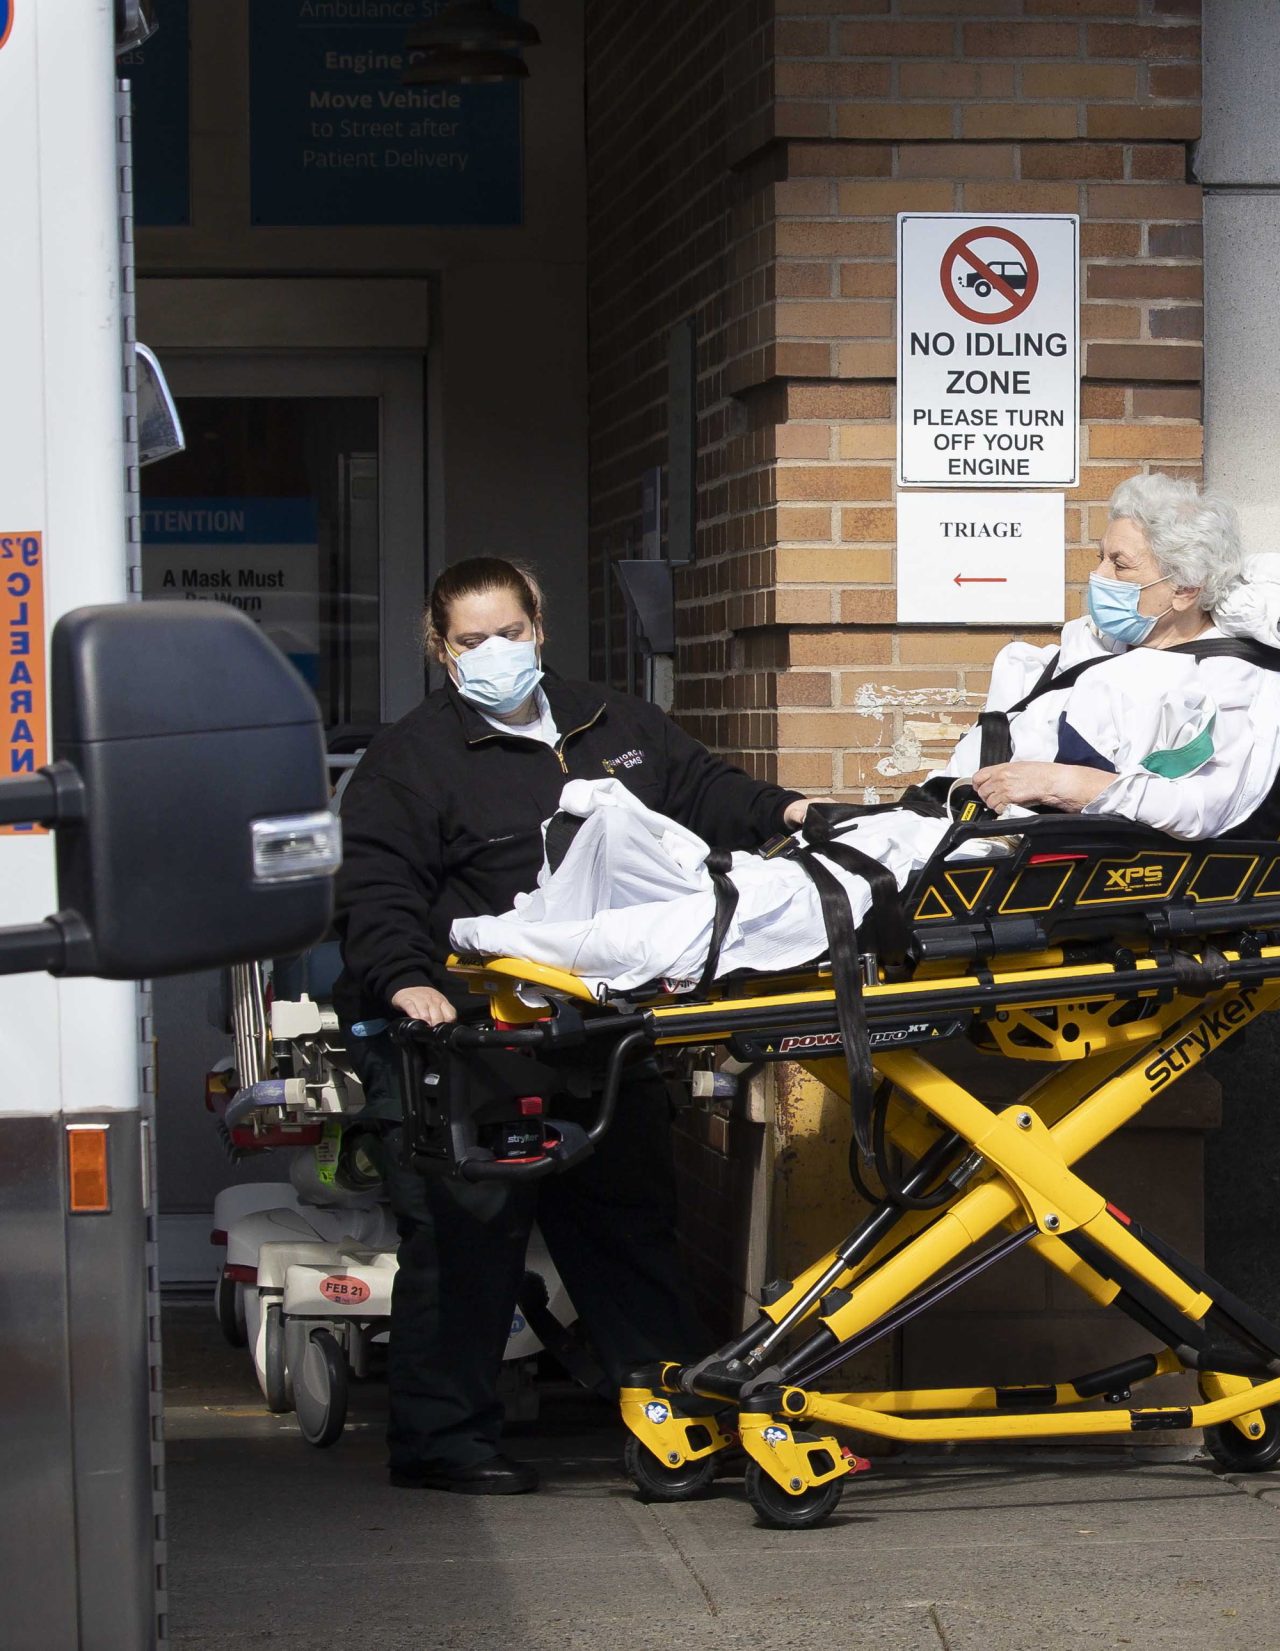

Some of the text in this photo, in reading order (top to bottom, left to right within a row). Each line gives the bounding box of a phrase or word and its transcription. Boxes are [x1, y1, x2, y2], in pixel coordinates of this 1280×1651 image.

[299, 0, 415, 17] Ambulance
[325, 51, 402, 74] Engine
[309, 89, 461, 109] Move Vehicle
[311, 117, 460, 138] to Street after
[303, 148, 469, 171] Patient Delivery
[910, 331, 1068, 357] NO IDLING
[946, 370, 1031, 395] ZONE
[913, 409, 1064, 427] PLEASE TURN
[933, 433, 1044, 451] OFF YOUR
[948, 458, 1030, 476] ENGINE
[141, 510, 245, 532] TTENTION
[940, 521, 1023, 538] TRIAGE
[162, 569, 285, 587] A Mask Must
[623, 756, 643, 769] EMS
[1105, 865, 1163, 887] XPS
[779, 1023, 929, 1053] pow pro XT
[1145, 988, 1257, 1093] stryker
[326, 1282, 363, 1297] FEB 21
